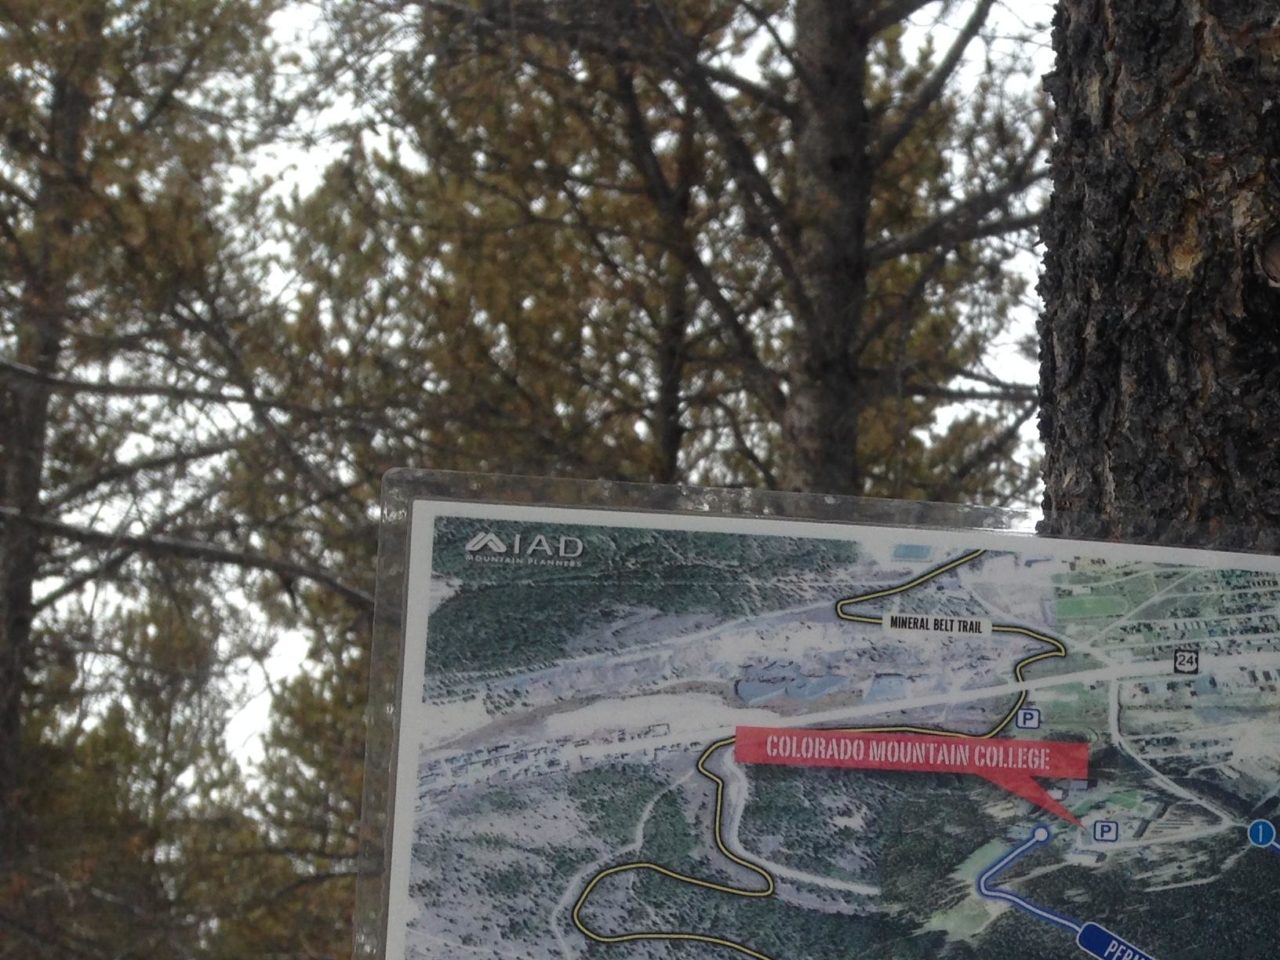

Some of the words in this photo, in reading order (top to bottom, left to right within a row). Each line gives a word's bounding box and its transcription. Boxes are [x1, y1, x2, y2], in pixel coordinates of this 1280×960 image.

[890, 615, 930, 631] MINERAL
[933, 618, 955, 632] BELT
[957, 619, 983, 634] TRAIL
[1178, 653, 1195, 667] 24
[766, 735, 865, 761] COLORADO
[868, 740, 970, 767] MOUNTAIN
[974, 746, 1051, 770] COLLEGE
